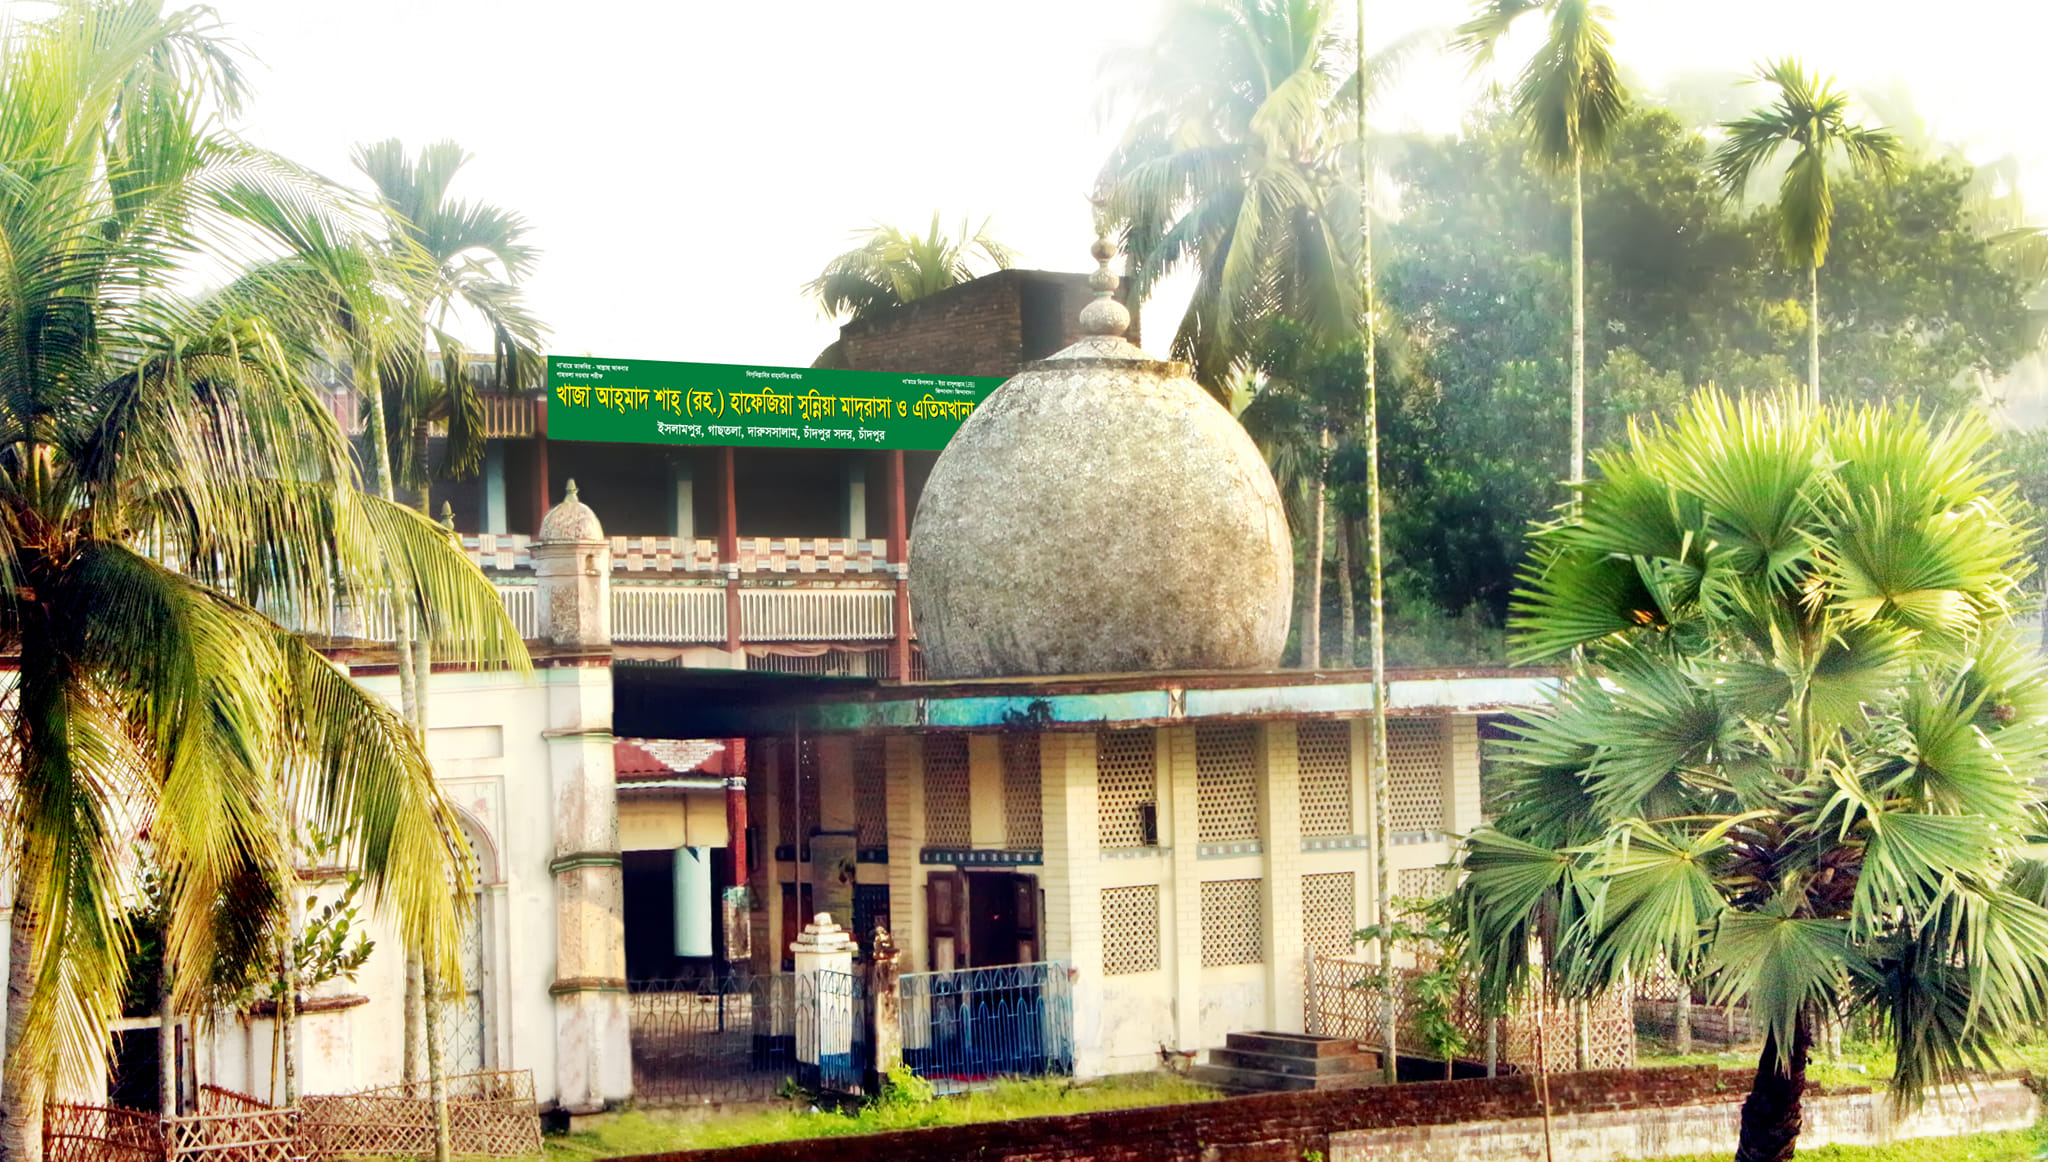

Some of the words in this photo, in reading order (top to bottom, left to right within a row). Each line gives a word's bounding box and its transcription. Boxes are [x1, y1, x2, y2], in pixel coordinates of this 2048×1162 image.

[556, 383, 592, 409] খাজা
[686, 388, 725, 419] (রহ.)
[728, 387, 795, 417] হাফেজিয়া
[797, 389, 837, 422] সুন্নিয়া
[896, 399, 908, 418] ও
[912, 393, 976, 422] এতিমখানা
[657, 420, 705, 438] ইসলামপুর,
[707, 424, 745, 439] গাছতলা,
[747, 426, 801, 440] দারুসসালাম,
[803, 424, 831, 442] চাঁদপুর
[833, 428, 856, 442] সদর,
[858, 426, 886, 443] চাঁদপুর
